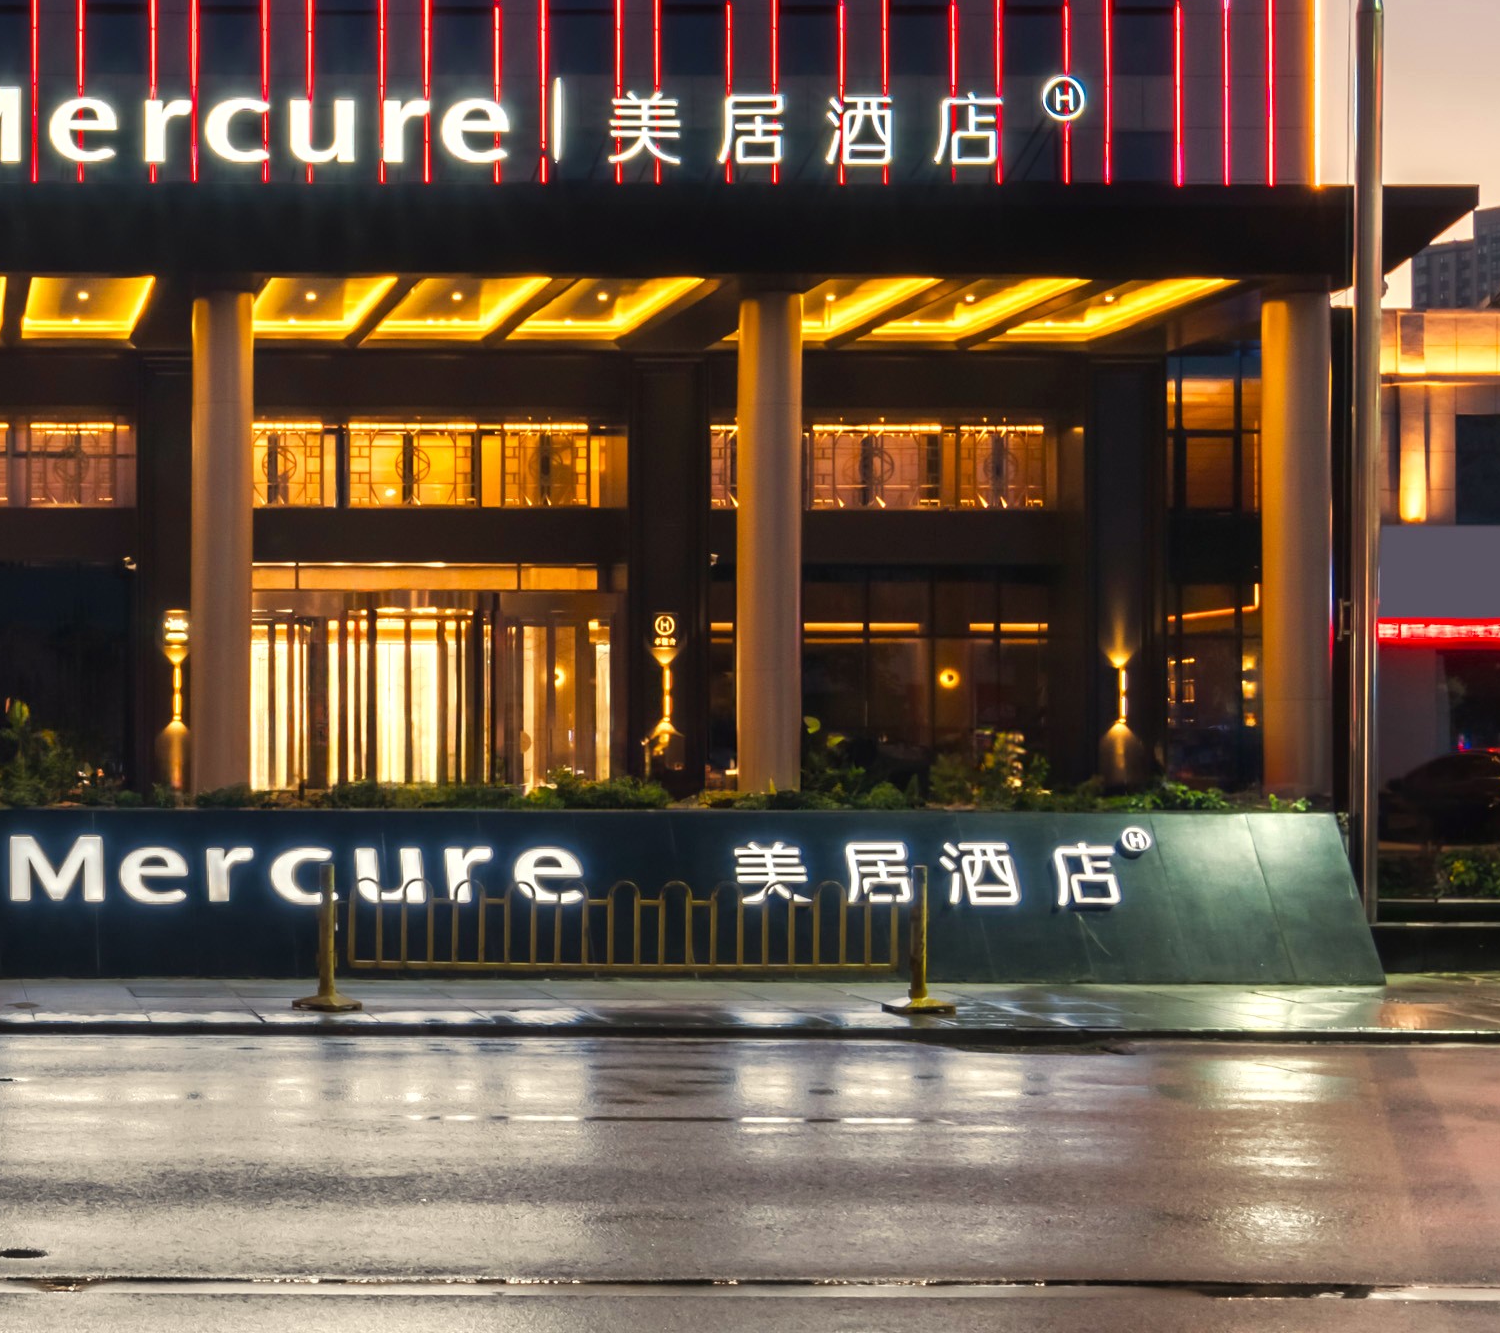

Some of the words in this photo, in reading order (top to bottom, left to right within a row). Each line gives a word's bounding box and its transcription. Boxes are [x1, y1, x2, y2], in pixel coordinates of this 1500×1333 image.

[608, 91, 1003, 165] 美居酒店
[9, 835, 584, 905] Mercure
[734, 841, 1122, 906] 美居酒店
